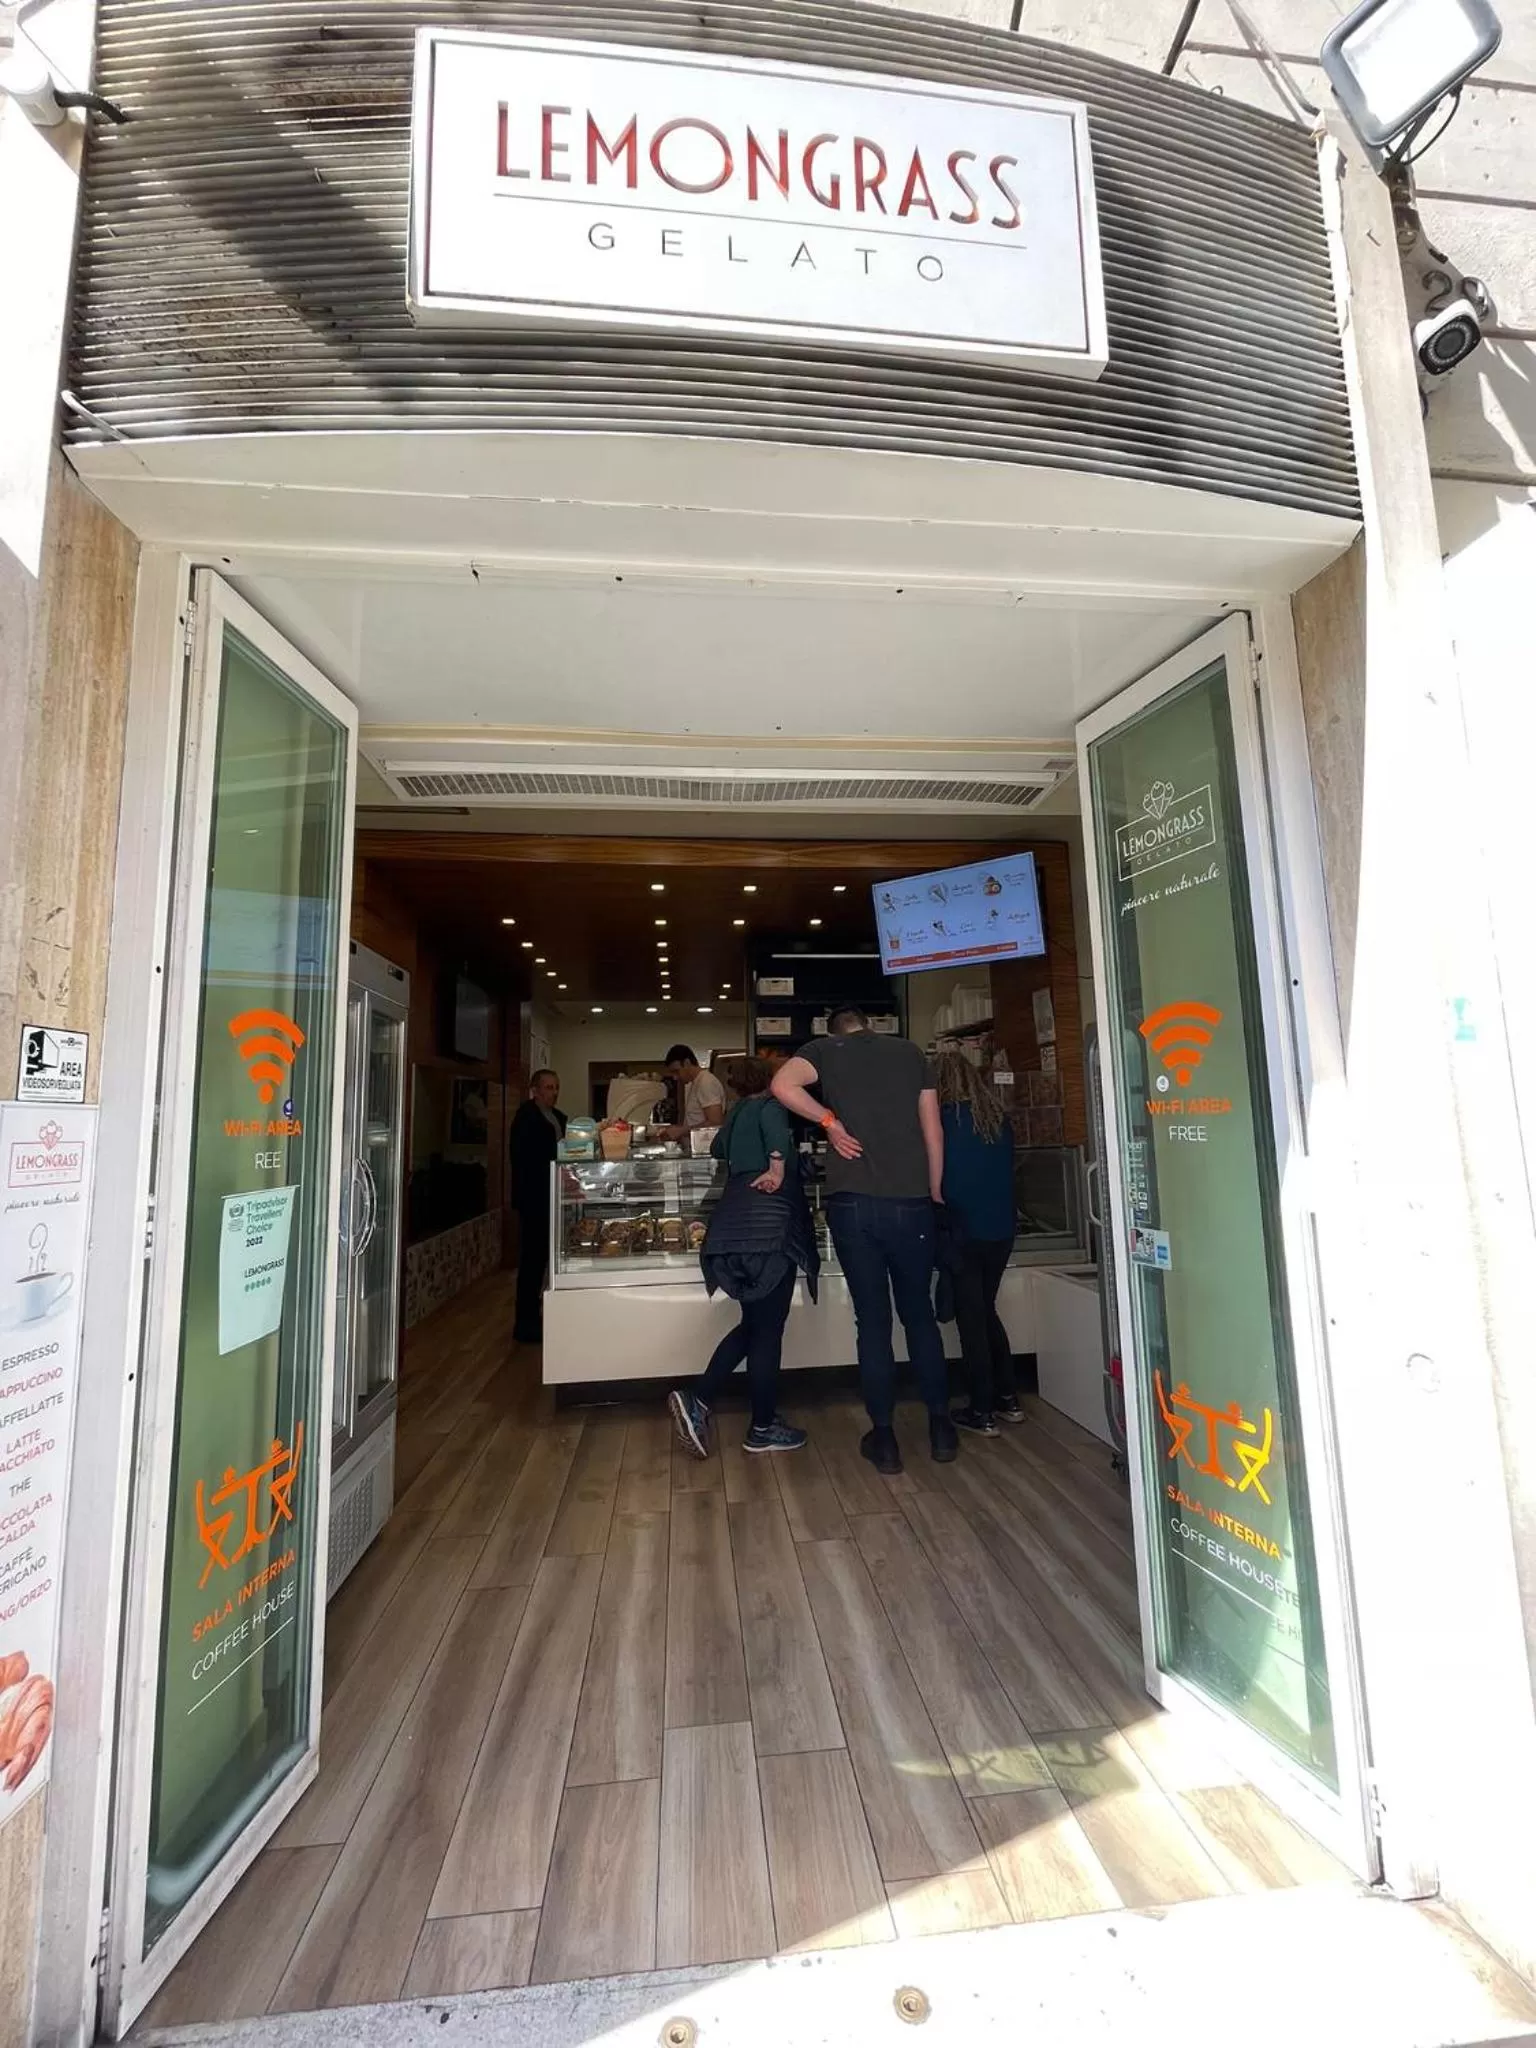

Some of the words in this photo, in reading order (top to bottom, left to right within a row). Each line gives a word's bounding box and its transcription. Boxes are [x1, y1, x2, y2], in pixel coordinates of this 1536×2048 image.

[495, 99, 1022, 230] LEMONGRASS
[587, 221, 945, 283] GELATO
[1122, 805, 1205, 858] LEMONGRASS
[1165, 861, 1221, 896] naturale
[60, 1061, 83, 1077] AREA
[1146, 1099, 1185, 1115] WI-FI
[1188, 1097, 1232, 1115] AREA
[266, 1119, 303, 1137] AREA
[1168, 1125, 1208, 1141] FREE
[15, 1153, 79, 1170] LEMONGRASS
[254, 1151, 282, 1169] REE
[247, 1196, 288, 1213] Tripadvisor
[245, 1236, 264, 1248] 2022
[246, 1223, 273, 1235] Choice
[244, 1258, 285, 1278] LEMONGRASS
[2, 1341, 60, 1372] ESPRESSO
[6, 1427, 42, 1455] LATTE
[0, 1492, 53, 1530] CCOLATA
[1167, 1484, 1205, 1517] SALA
[1208, 1509, 1283, 1561] INTERNA
[1169, 1517, 1228, 1562] COFFEE
[1229, 1551, 1287, 1600] HOUSE
[192, 1599, 233, 1642] SALA
[238, 1548, 296, 1606] INTERNA
[191, 1619, 250, 1681] COFFEE
[252, 1580, 295, 1630] HOUSE
